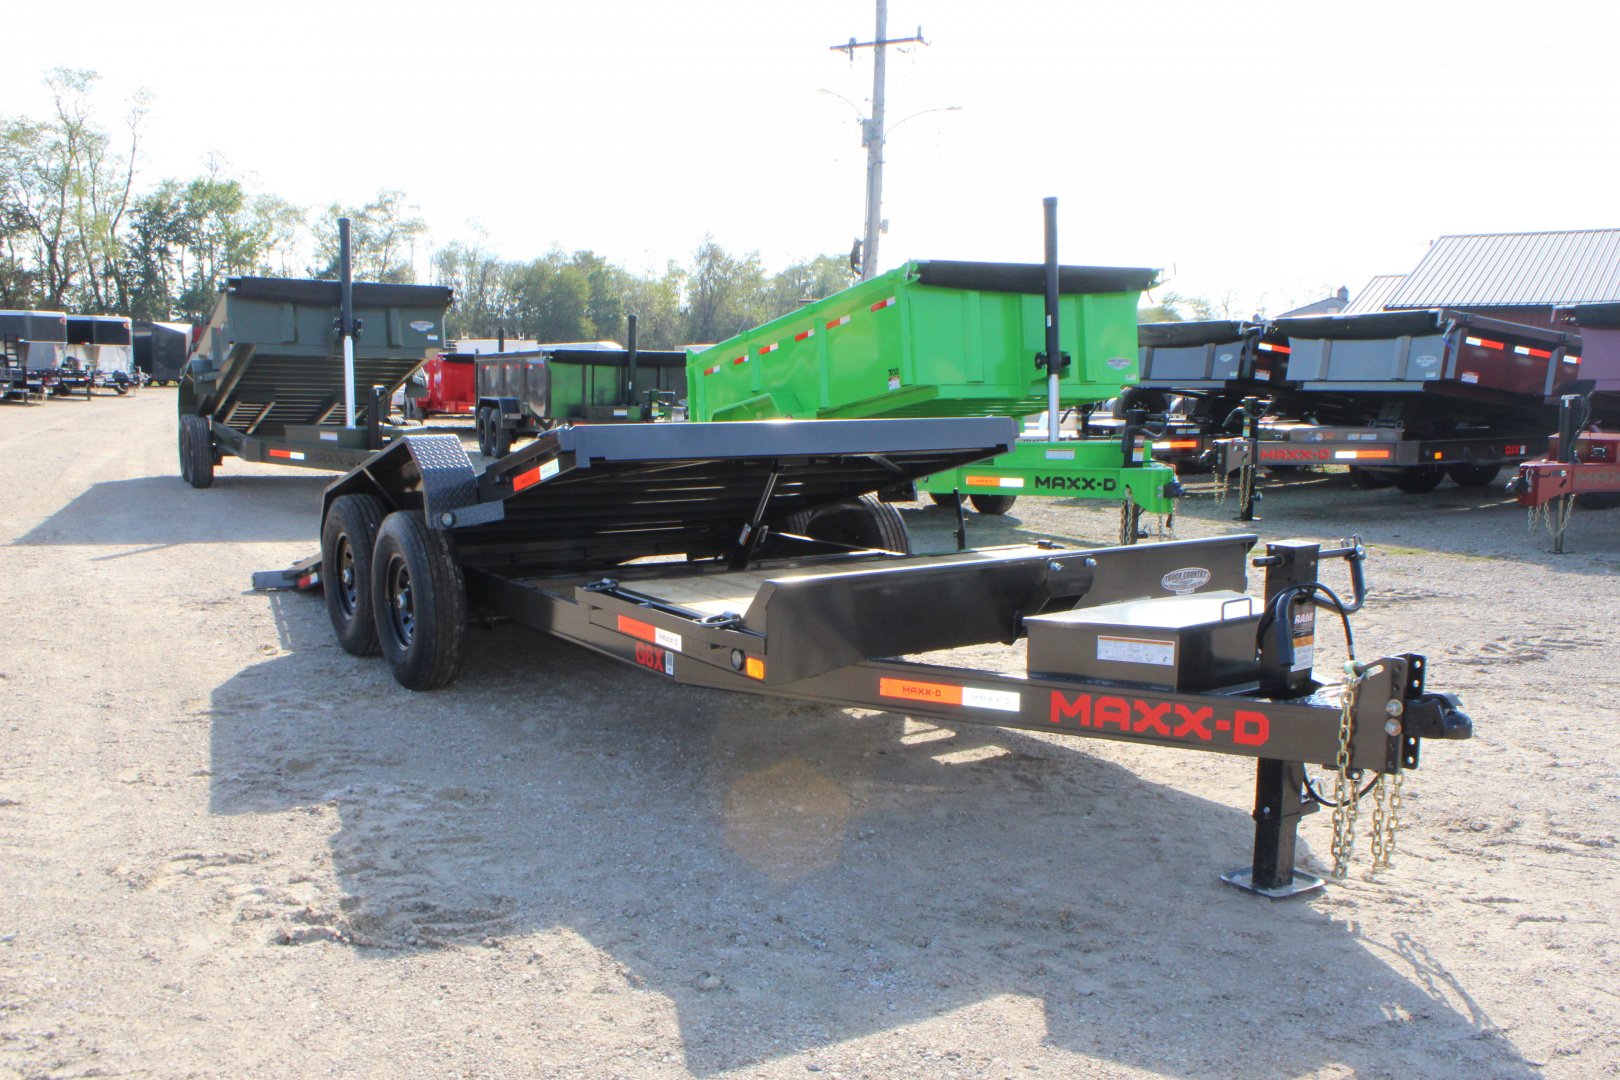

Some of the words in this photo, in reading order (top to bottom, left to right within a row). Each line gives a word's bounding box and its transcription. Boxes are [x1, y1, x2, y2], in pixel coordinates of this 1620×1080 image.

[1260, 449, 1330, 460] MAXX-D
[1505, 446, 1520, 455] DJX
[1035, 476, 1116, 491] MAXX-D
[1165, 571, 1182, 583] TRUCK
[1183, 569, 1207, 580] COUNTRY
[1294, 612, 1313, 624] RAM
[635, 641, 664, 673] G6X
[902, 686, 941, 697] MAXX-D
[1050, 690, 1270, 746] MAXX-D
